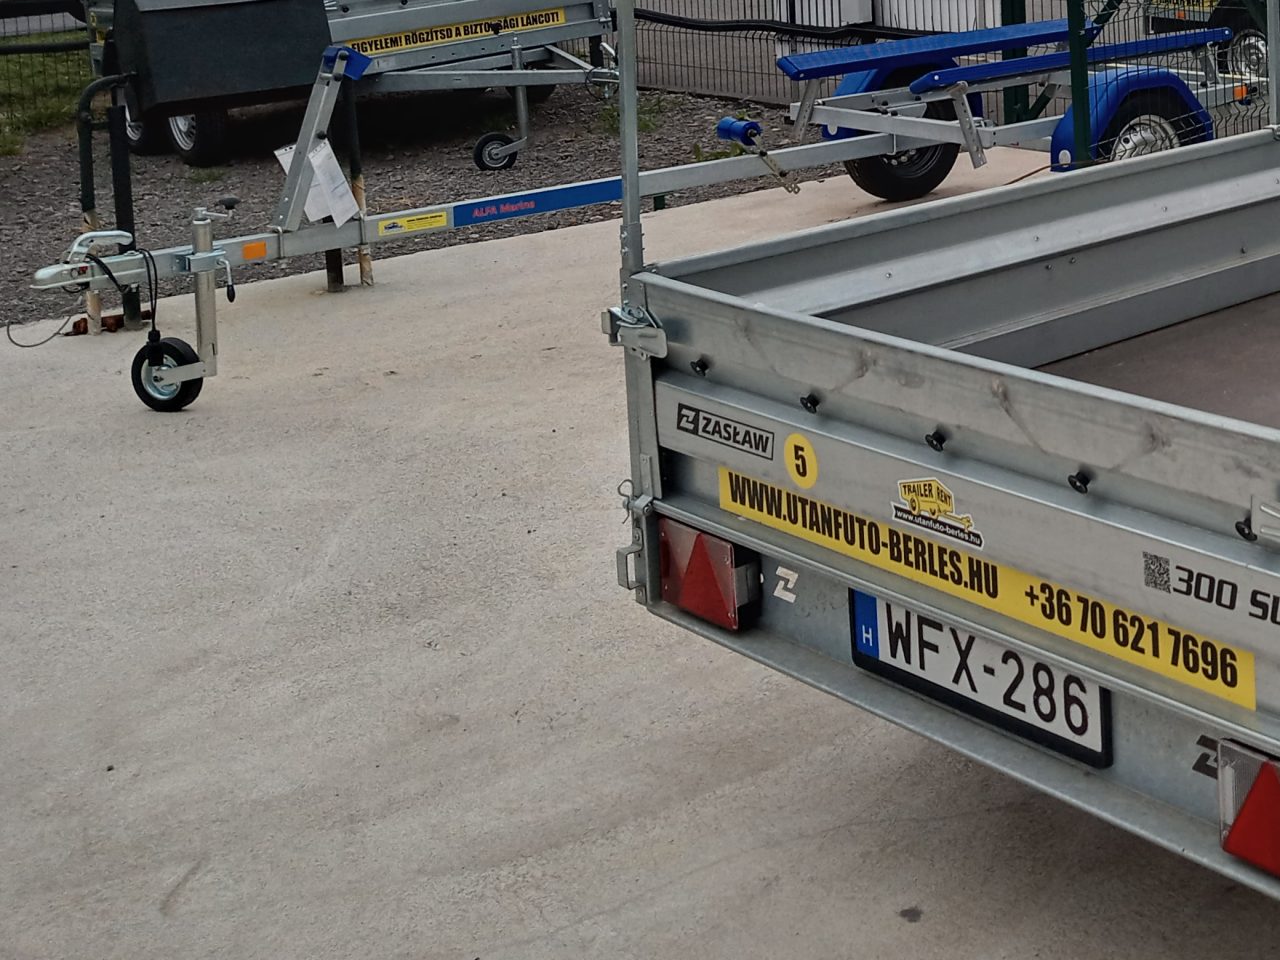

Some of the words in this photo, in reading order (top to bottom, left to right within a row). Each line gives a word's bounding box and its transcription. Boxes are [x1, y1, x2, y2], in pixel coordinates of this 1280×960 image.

[352, 36, 402, 52] FIGYELEM!
[405, 28, 452, 45] RÖGZÍTSD
[455, 27, 462, 37] A
[464, 17, 519, 35] BIZTOSÁGI
[521, 12, 559, 27] LÁNCOT!
[701, 417, 769, 453] ZASŁAW
[794, 444, 807, 478] 5
[903, 483, 933, 498] TRAILER
[937, 487, 951, 506] RENT
[728, 472, 999, 598] WWW.UTANFUTO-BERLES.HU
[896, 510, 980, 544] www.utanfuto-berles.hu
[1173, 565, 1238, 610] 300
[862, 625, 873, 647] H
[1025, 583, 1072, 626] +36
[1077, 596, 1106, 639] 70
[1113, 610, 1160, 658] 621
[1167, 628, 1238, 688] 7696
[886, 602, 1089, 736] WFX-286
